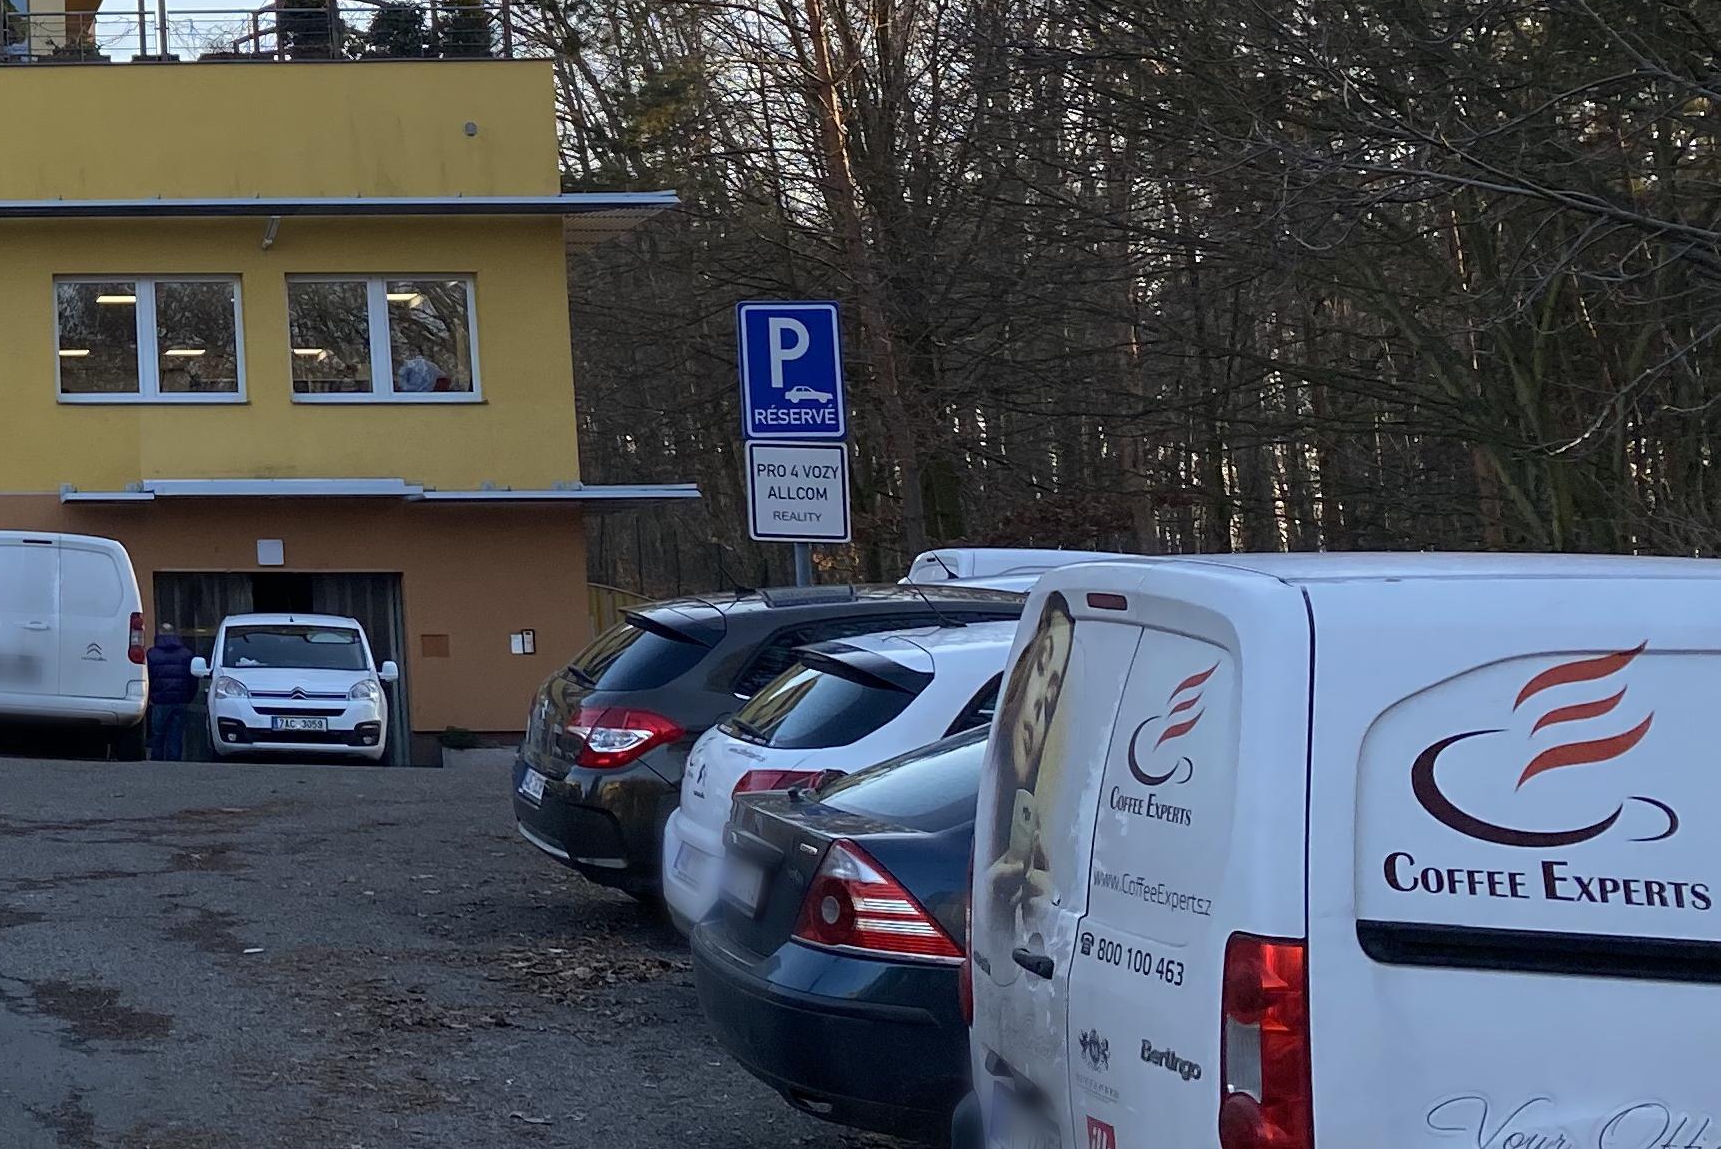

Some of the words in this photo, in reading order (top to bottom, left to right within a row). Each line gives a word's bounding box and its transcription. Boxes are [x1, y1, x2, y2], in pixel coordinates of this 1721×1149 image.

[768, 316, 811, 388] P
[754, 403, 837, 425] RÉSERVÉ
[757, 463, 786, 478] PRO
[790, 464, 799, 478] 4
[803, 465, 840, 480] VOZY
[767, 485, 828, 501] ALLCOM
[773, 510, 823, 523] REALITY
[1110, 786, 1144, 816] COFFEE
[1146, 793, 1192, 827] EXPERTS
[1383, 851, 1530, 899] COFFEE
[1541, 860, 1712, 911] EXPERTS
[1097, 938, 1122, 967] 800
[1127, 947, 1152, 976] 100
[1156, 957, 1185, 986] 463
[1141, 1038, 1202, 1081] Berlingo
